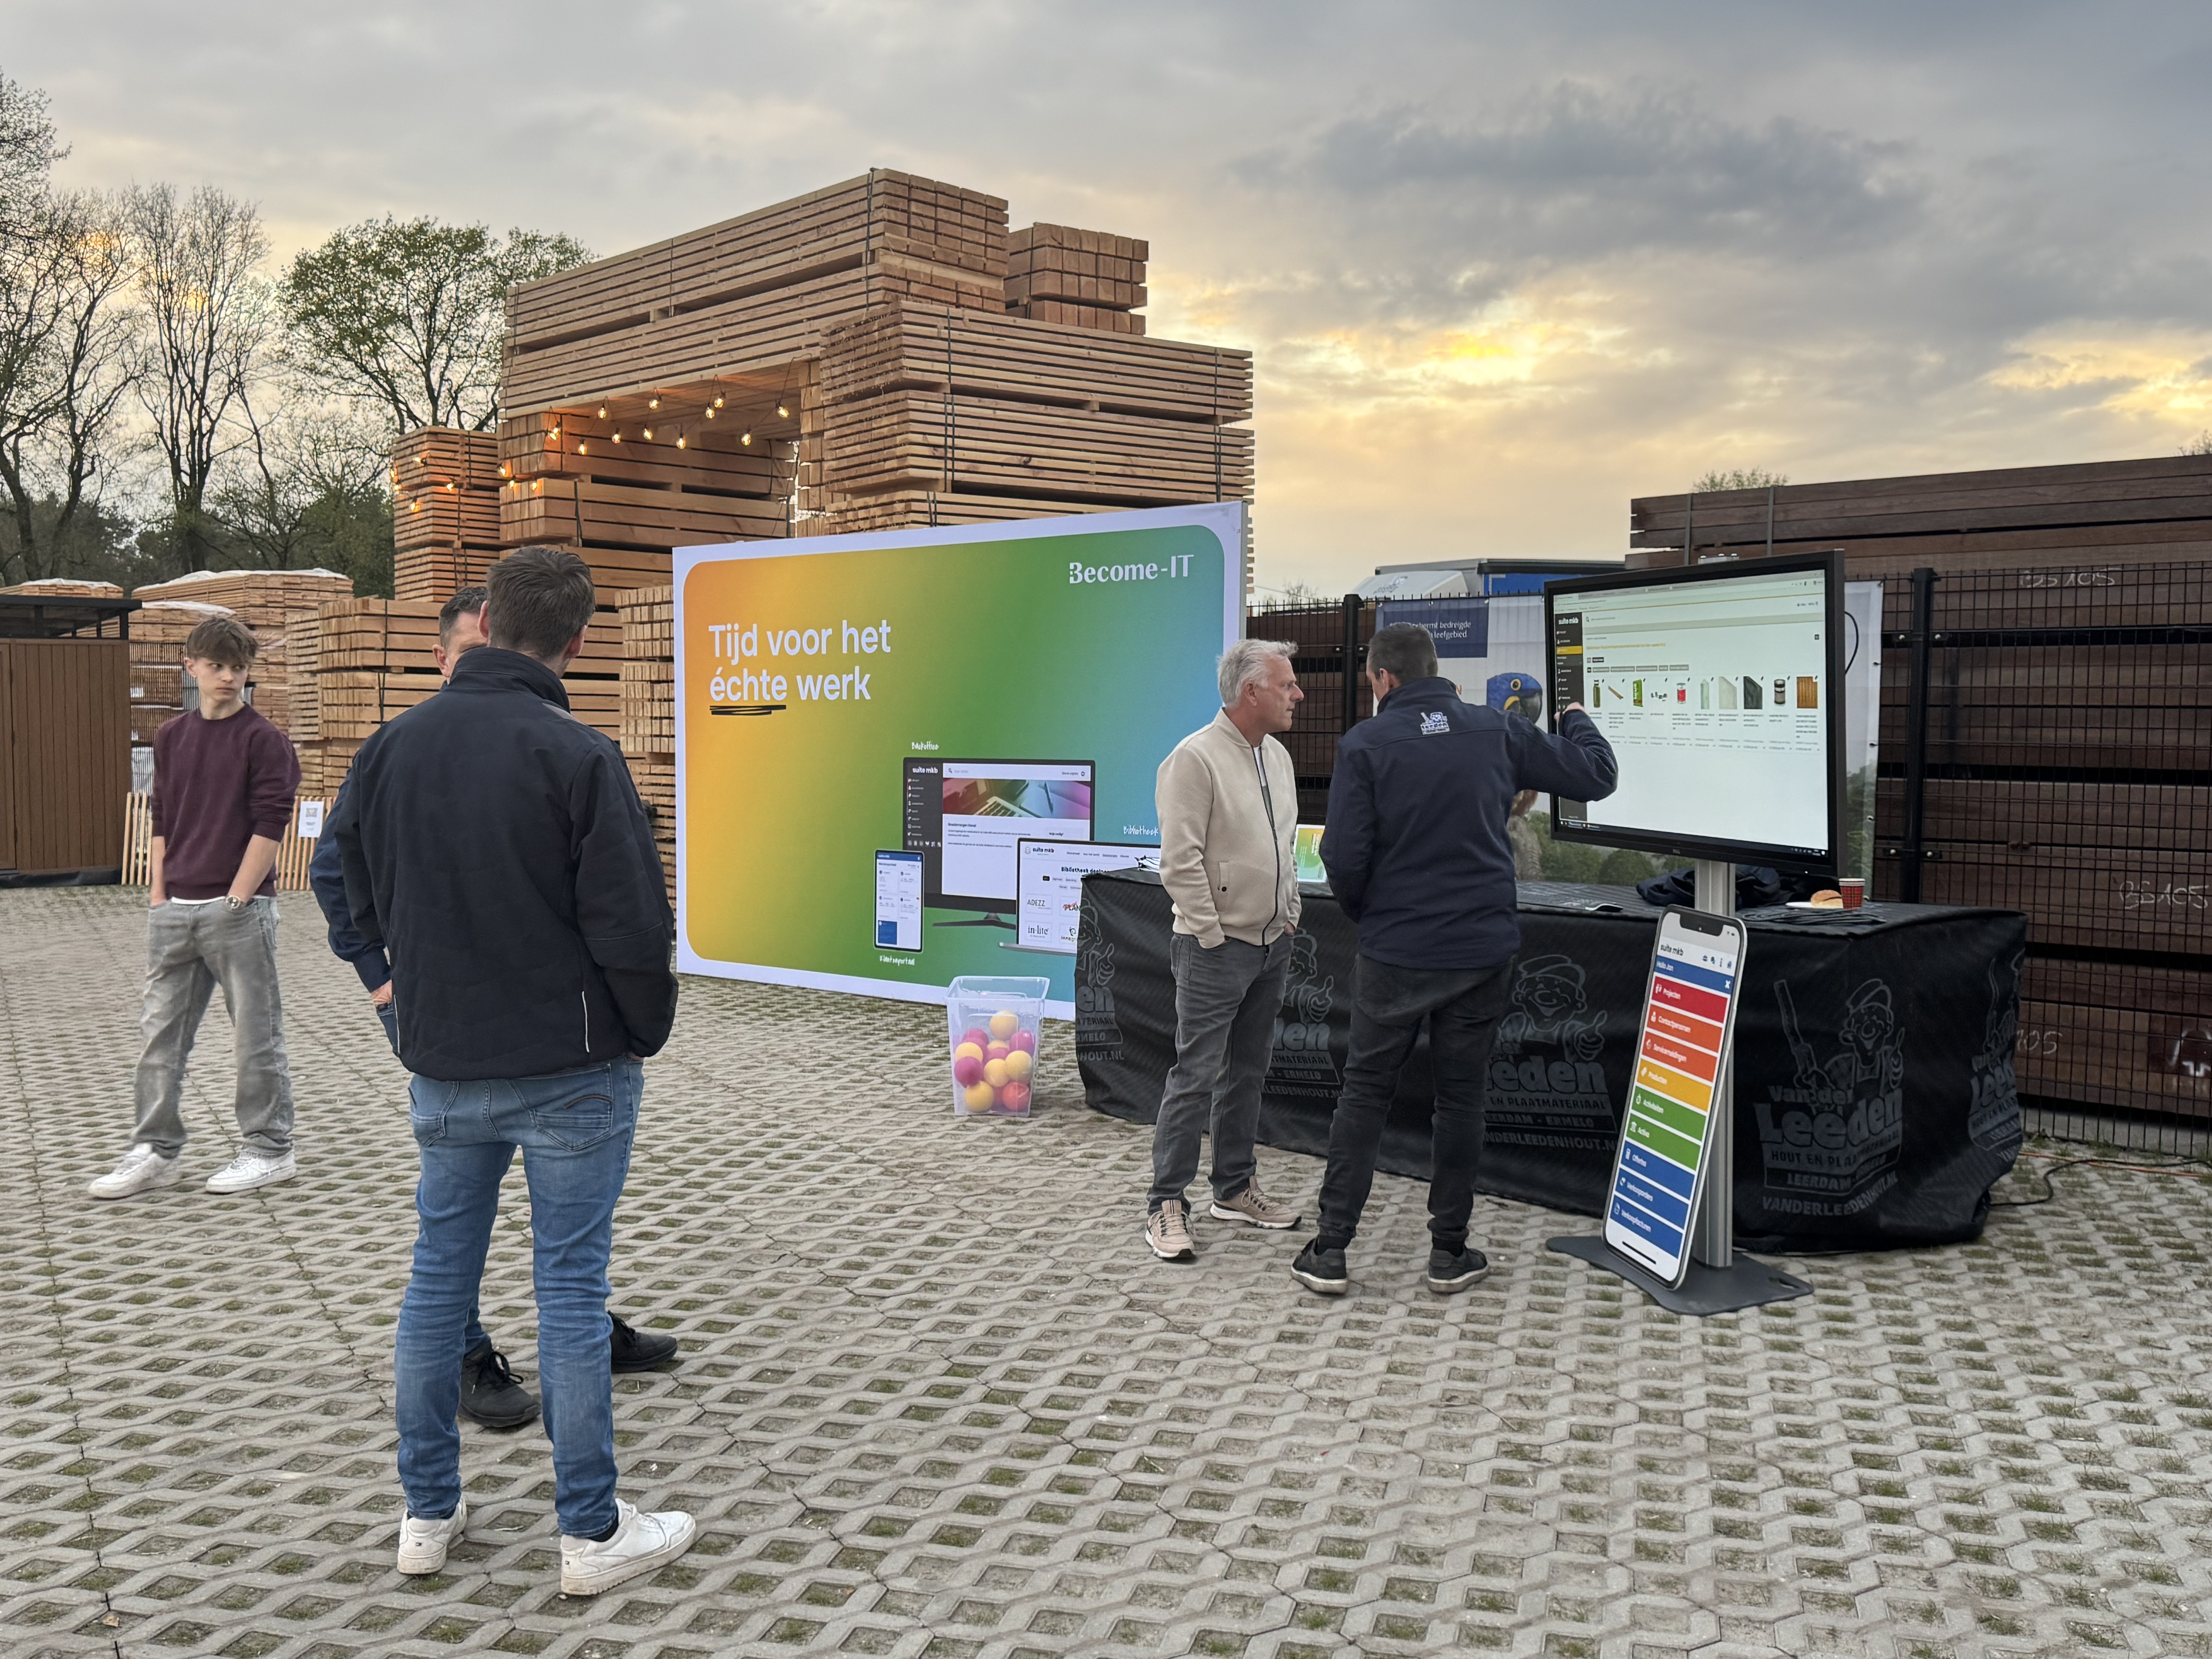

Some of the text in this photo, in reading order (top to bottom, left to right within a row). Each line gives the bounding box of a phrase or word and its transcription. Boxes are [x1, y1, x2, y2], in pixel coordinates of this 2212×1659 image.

[1069, 554, 1194, 584] Become-IT
[1439, 620, 1472, 630] bedreigde
[708, 620, 891, 665] Tijd voor het
[1434, 630, 1468, 641] leefgebied
[709, 666, 871, 701] échte werk
[911, 740, 939, 751] Backoffice
[1123, 824, 1159, 836] Bibliotheek
[1283, 1069, 1322, 1080] ERMELO
[1752, 1087, 1903, 1149] Leeden
[1771, 1151, 1801, 1164] HOUT
[1807, 1154, 1822, 1166] EN
[1786, 1172, 1851, 1190] LEERDAM
